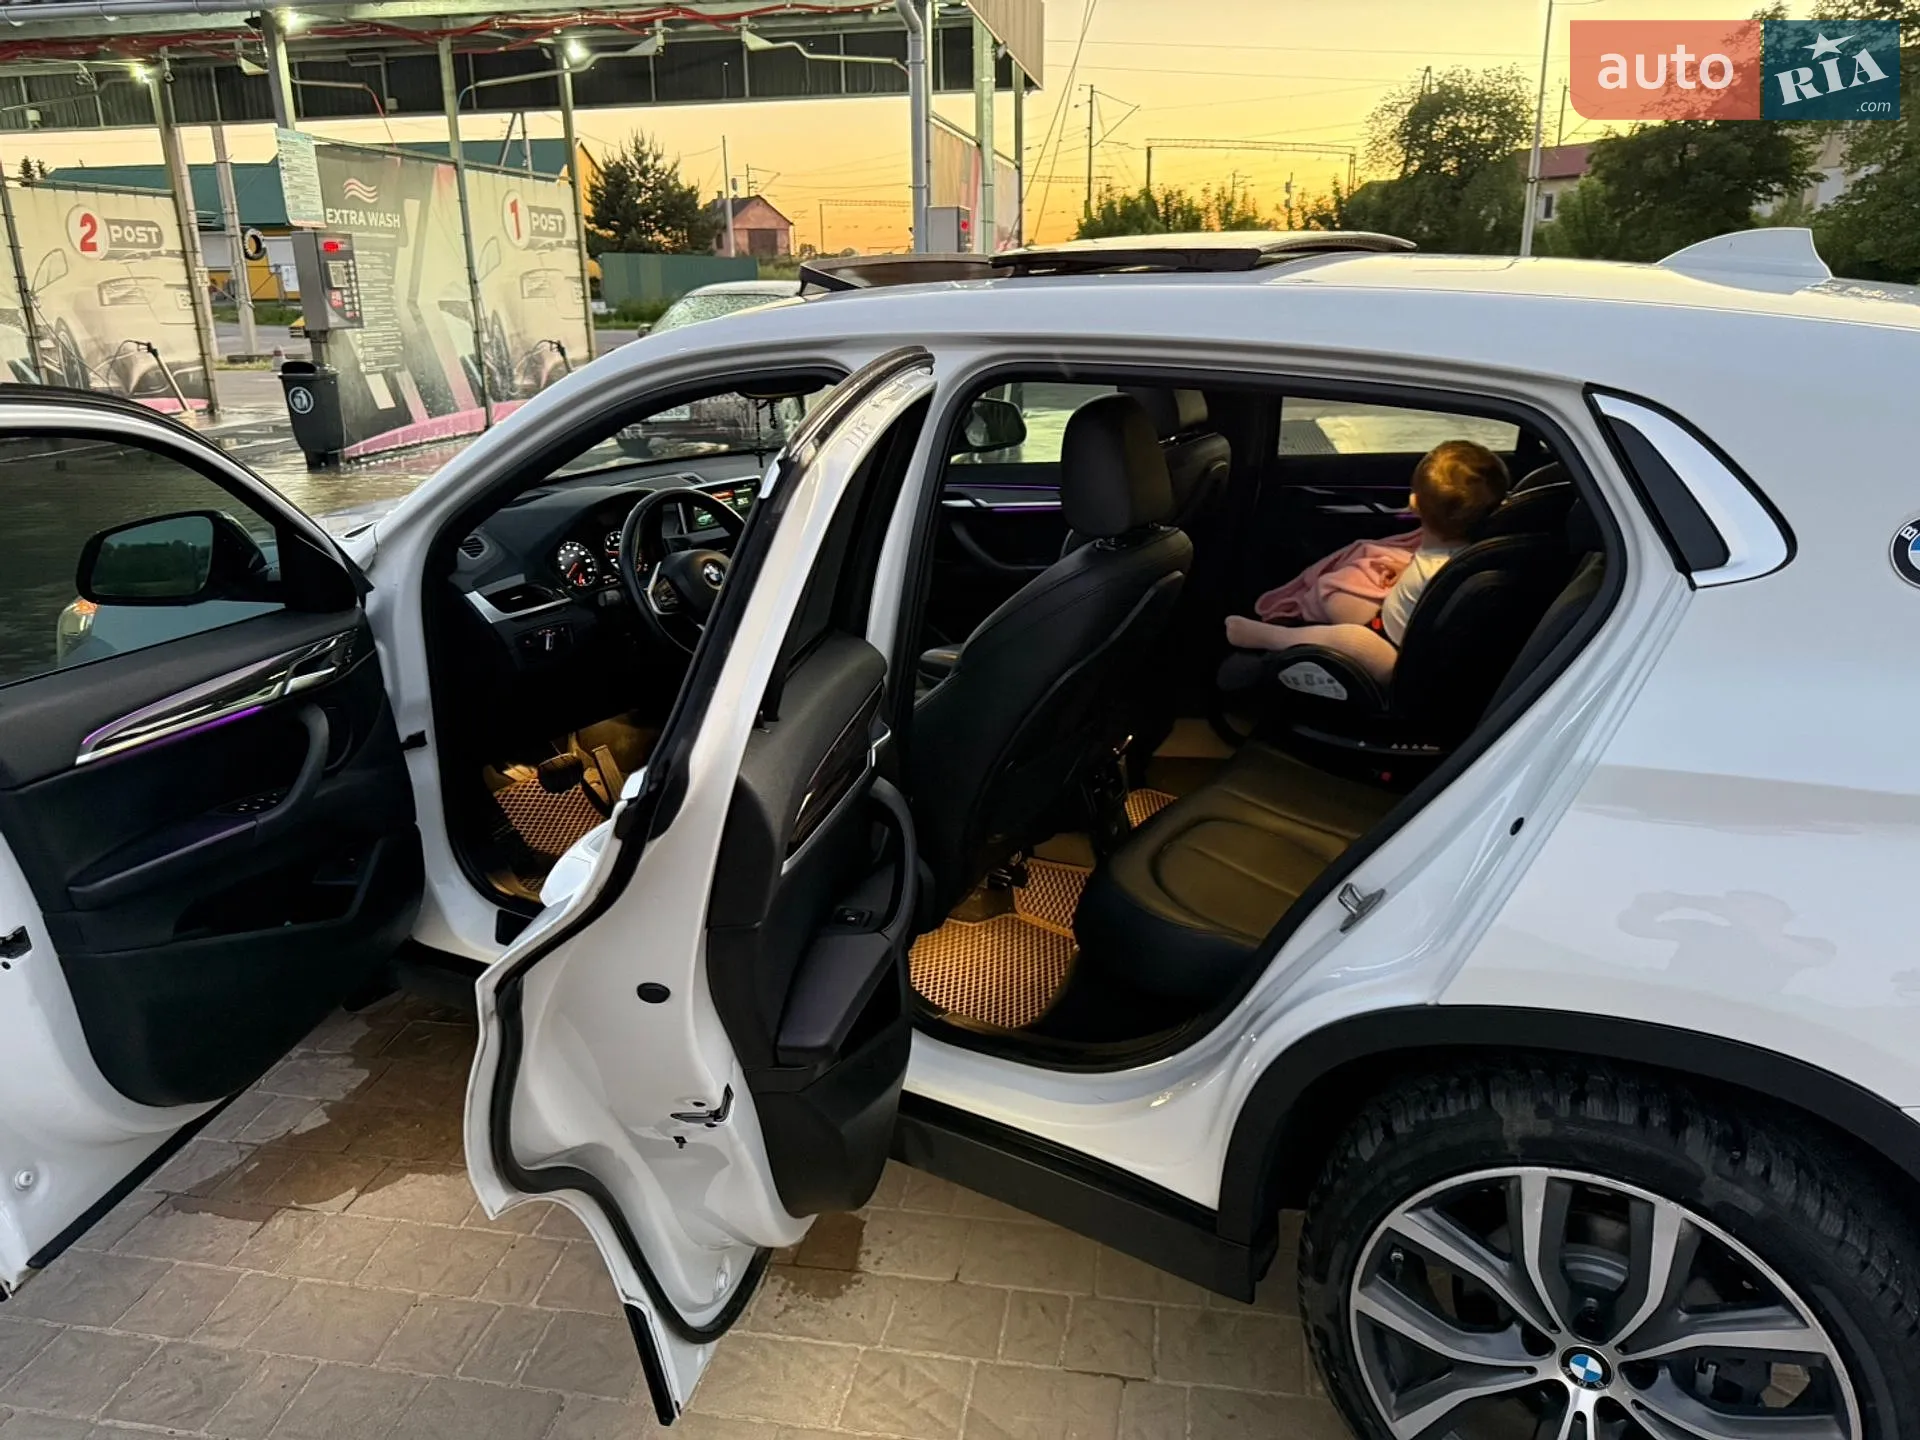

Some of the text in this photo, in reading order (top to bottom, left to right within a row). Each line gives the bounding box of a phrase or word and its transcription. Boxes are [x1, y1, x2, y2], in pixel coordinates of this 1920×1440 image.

[79, 212, 160, 252] 2 POST
[325, 207, 400, 229] EXTRA WASH
[509, 198, 564, 241] 1 POST
